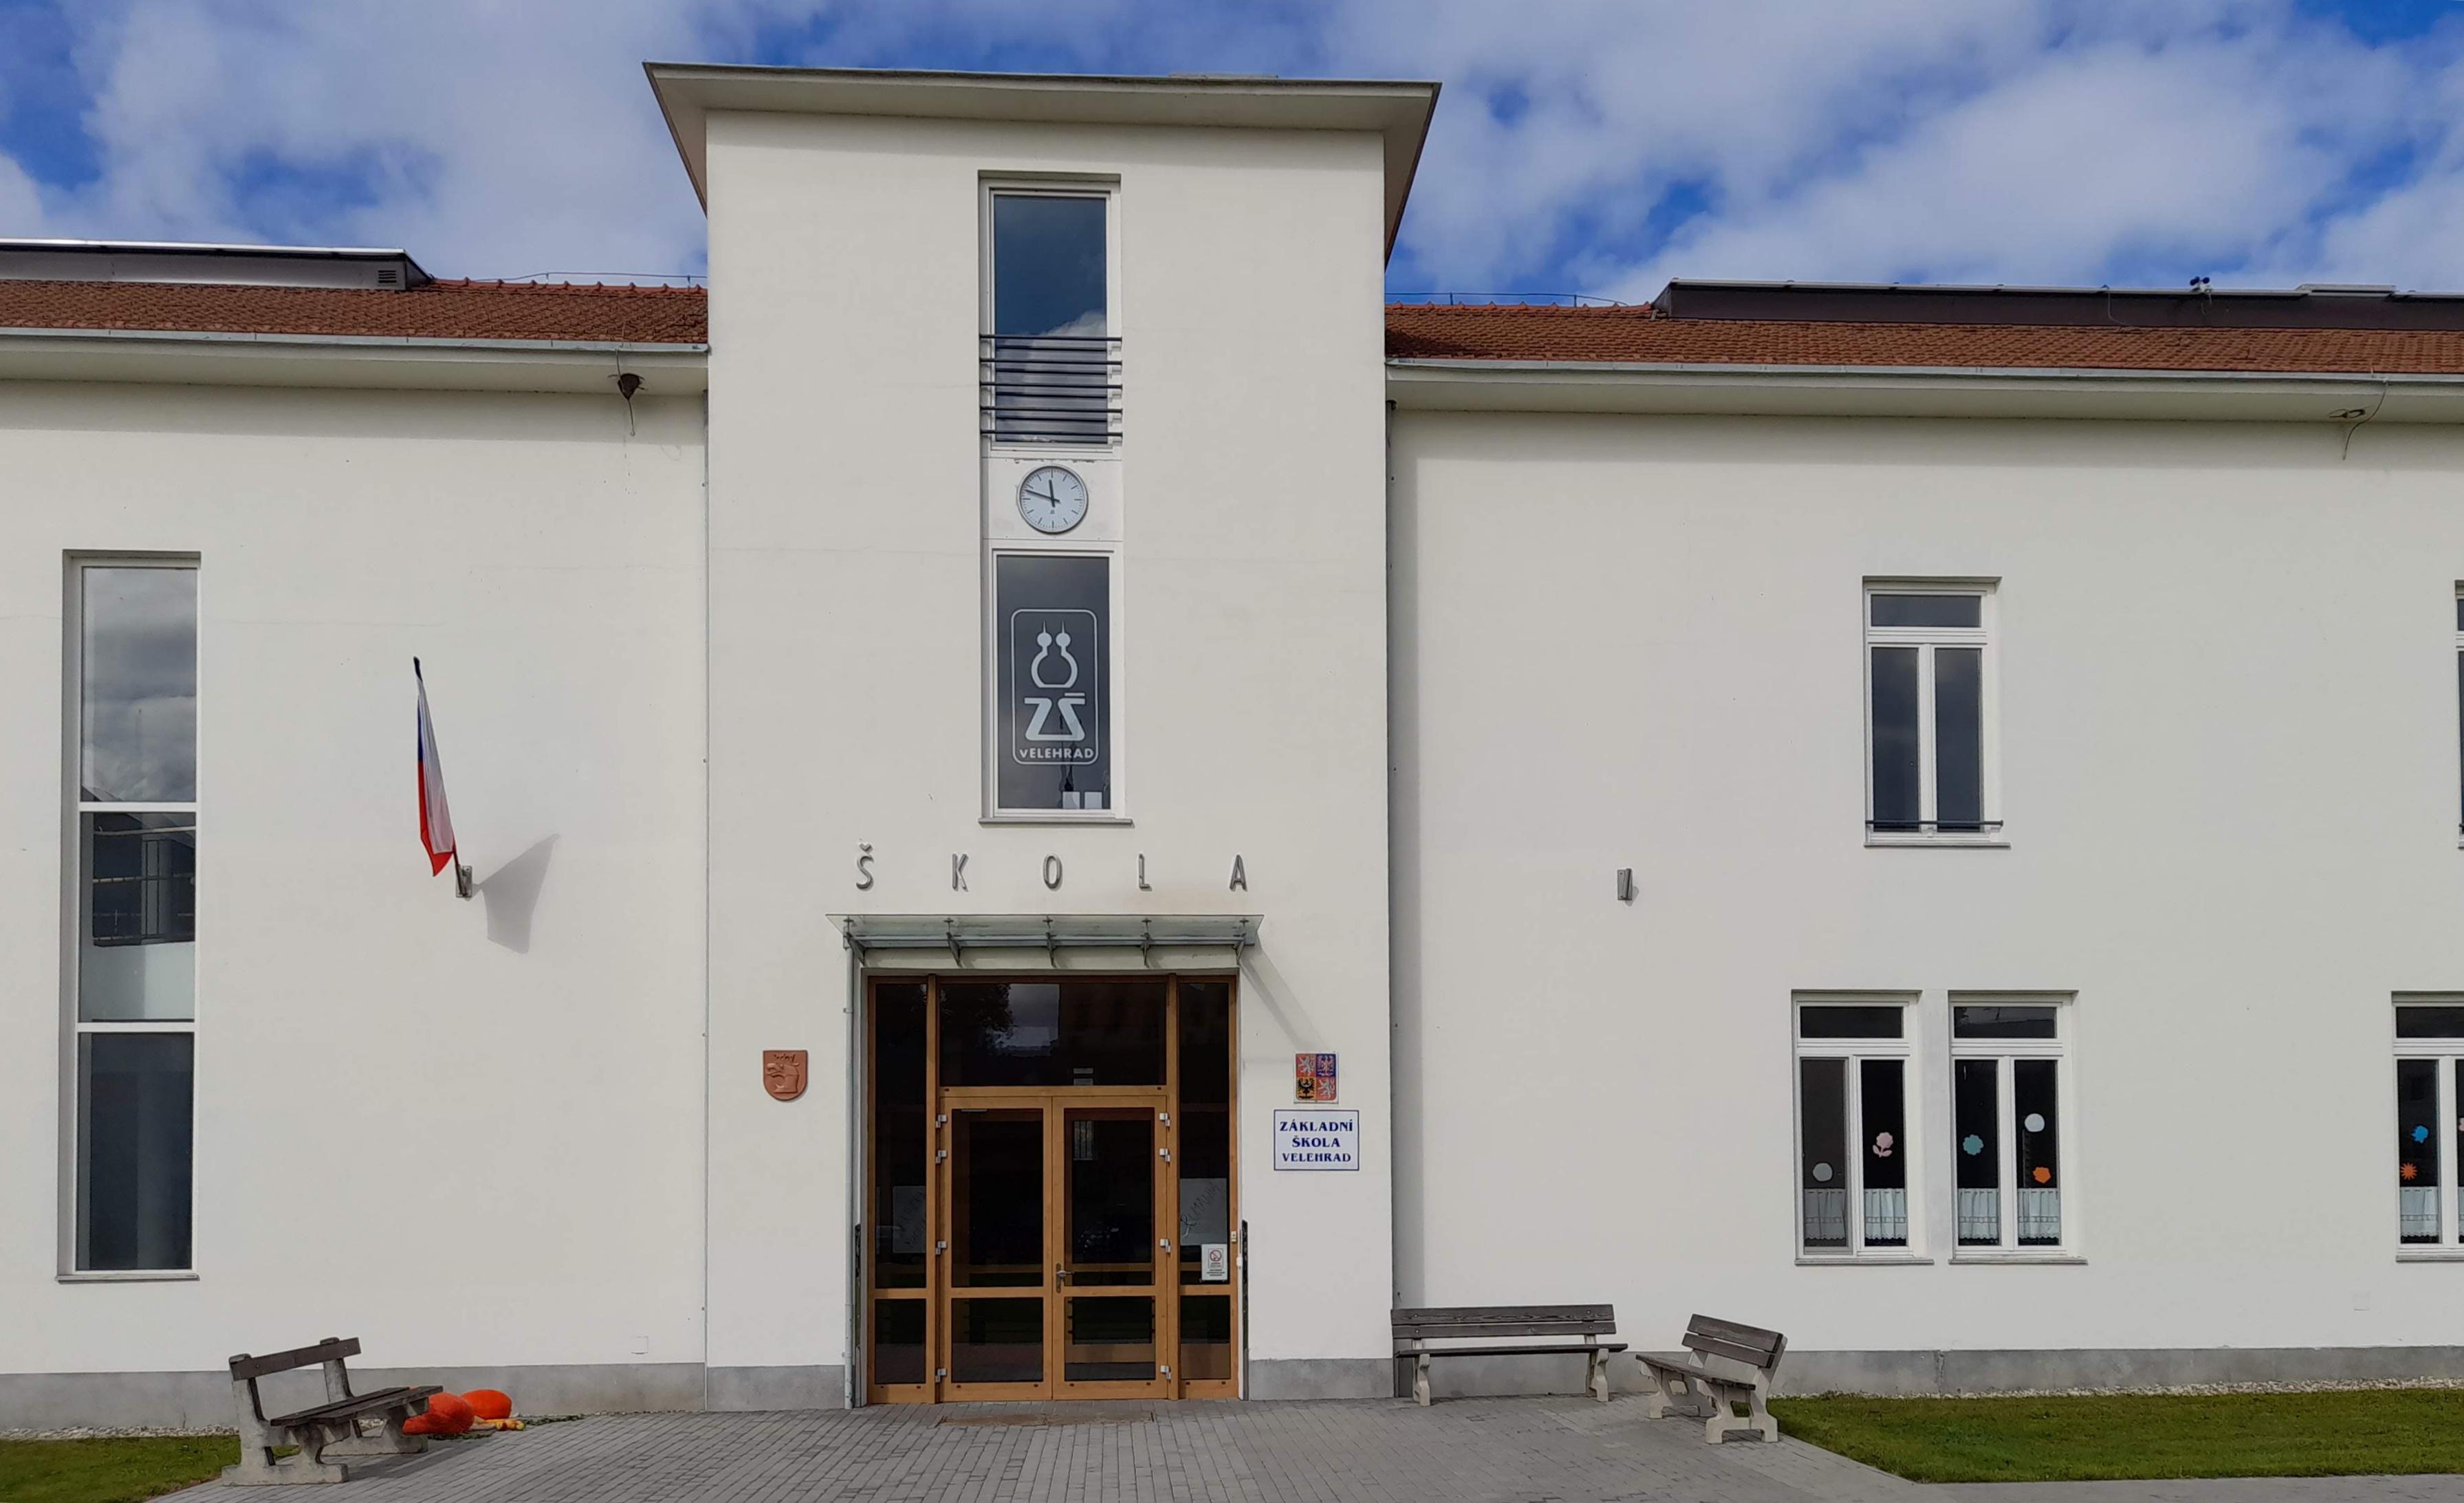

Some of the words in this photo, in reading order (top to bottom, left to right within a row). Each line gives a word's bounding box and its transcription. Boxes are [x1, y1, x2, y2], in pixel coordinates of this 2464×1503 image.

[1018, 747, 1094, 759] VELEHRAD
[855, 843, 1247, 891] ŠKOLA
[1280, 1119, 1353, 1131] ZÁKLADNÍ
[1292, 1135, 1340, 1147] ŠKOLA
[1283, 1154, 1351, 1162] VELEHRAD
